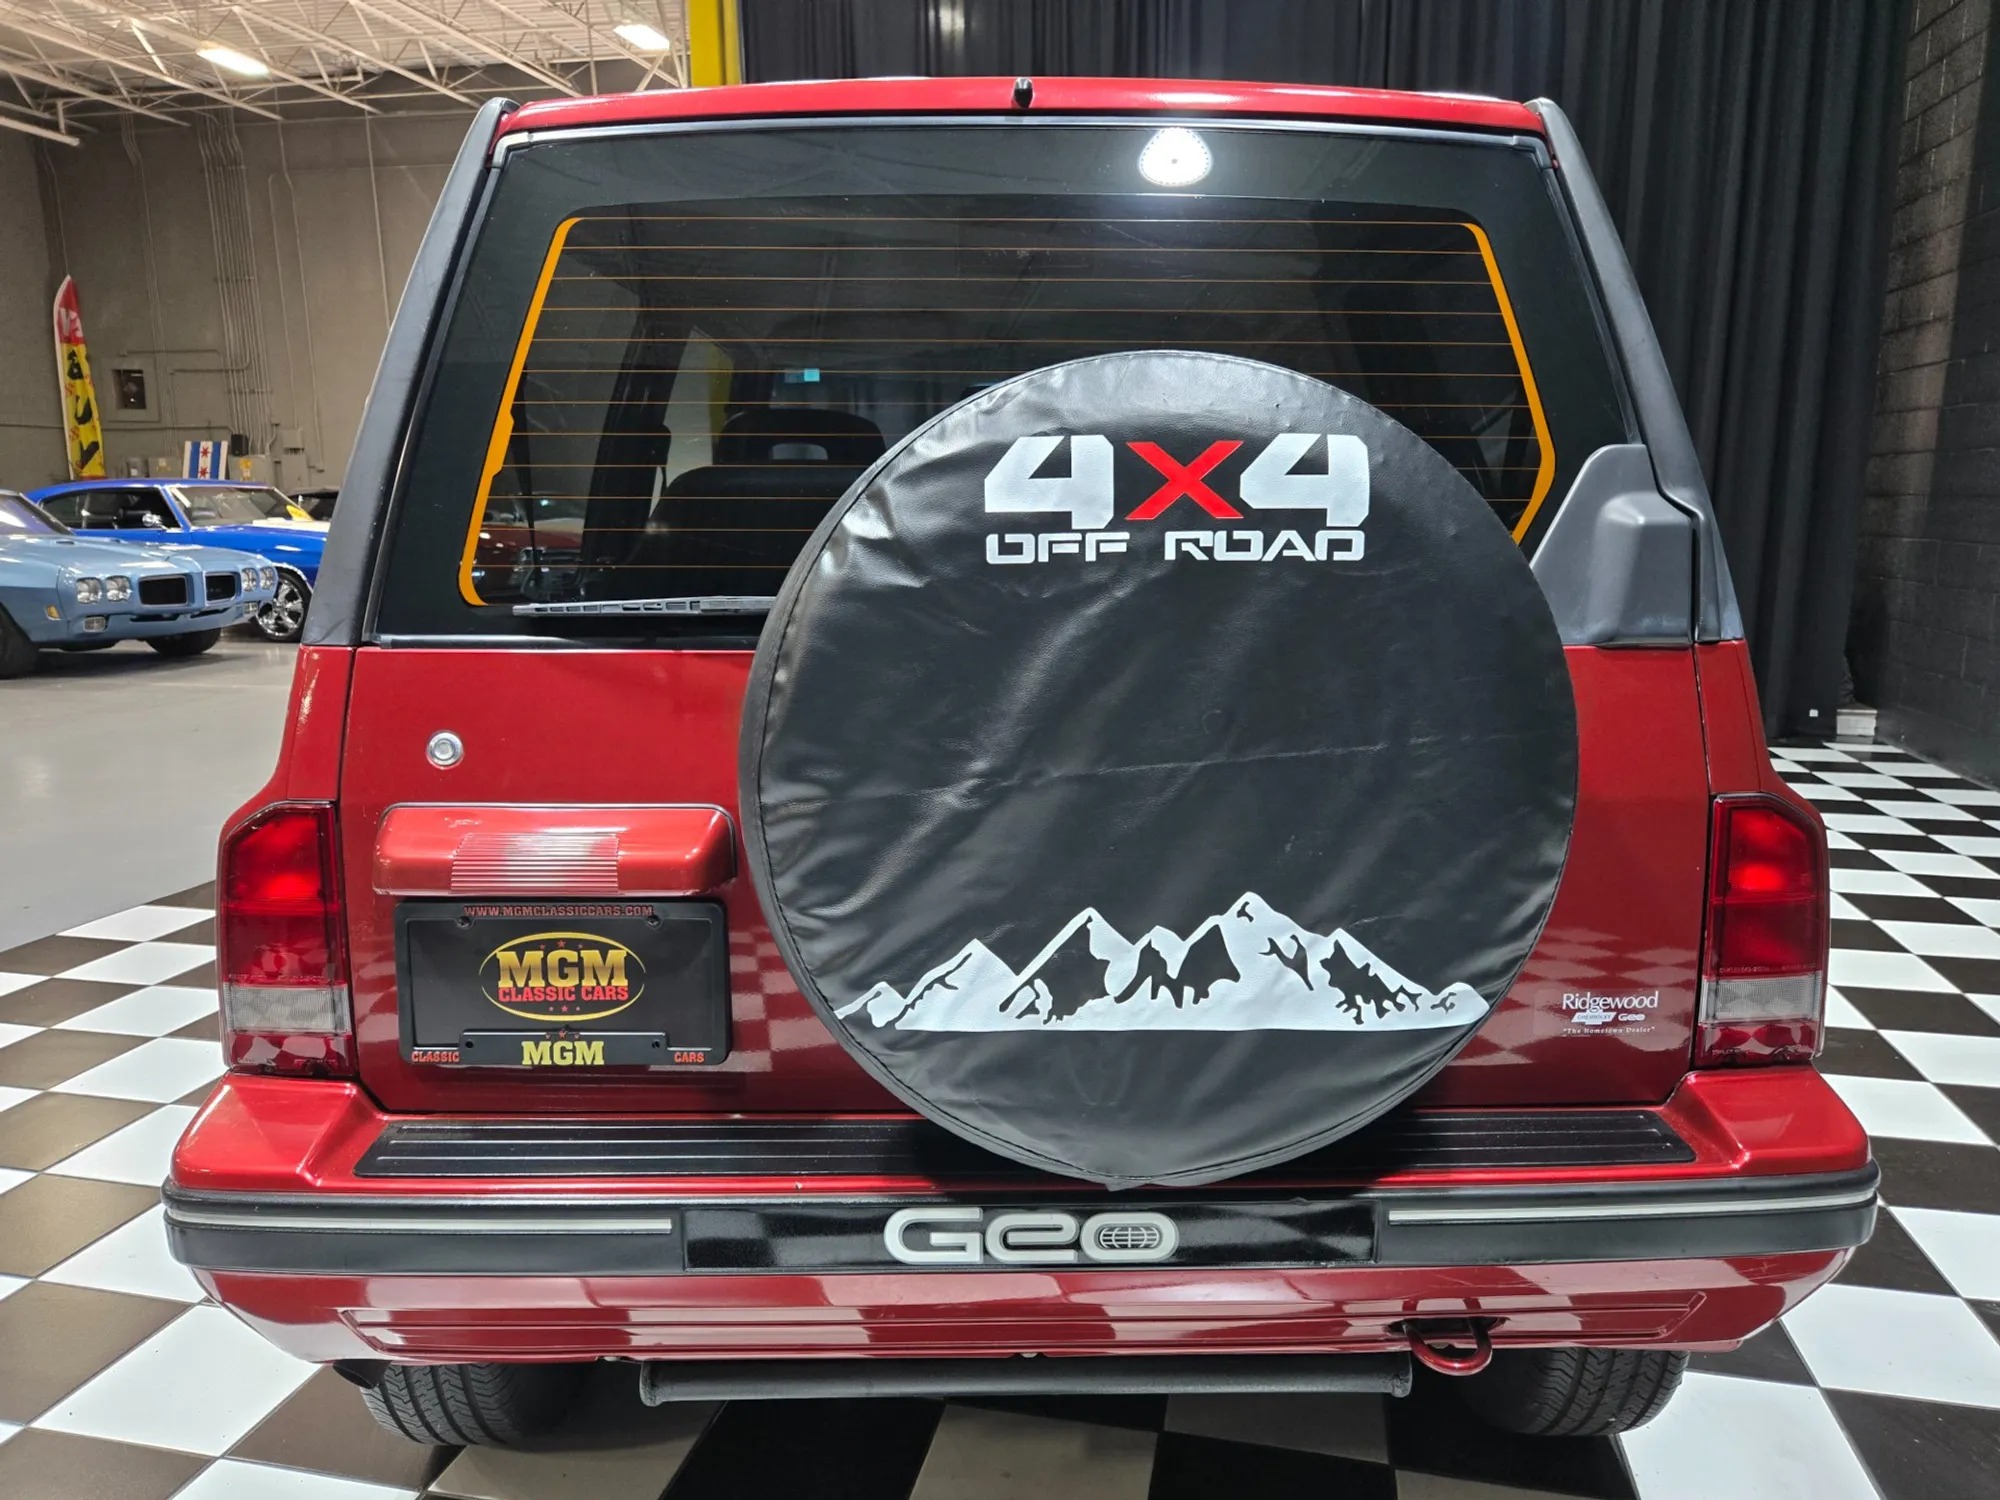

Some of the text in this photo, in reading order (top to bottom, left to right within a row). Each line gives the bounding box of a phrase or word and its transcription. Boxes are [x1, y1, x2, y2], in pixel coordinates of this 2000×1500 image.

[986, 530, 1365, 565] OFF ROAD
[463, 905, 654, 917] WWW.MGMCLASSICCARS.COM
[496, 949, 628, 988] MGM
[498, 985, 629, 1002] CLASSIC CARS
[1562, 990, 1659, 1013] Ridgewood
[411, 1051, 460, 1063] CLASSIC
[521, 1040, 605, 1066] MGM
[674, 1051, 705, 1063] CARS
[884, 1207, 1180, 1264] Geo
